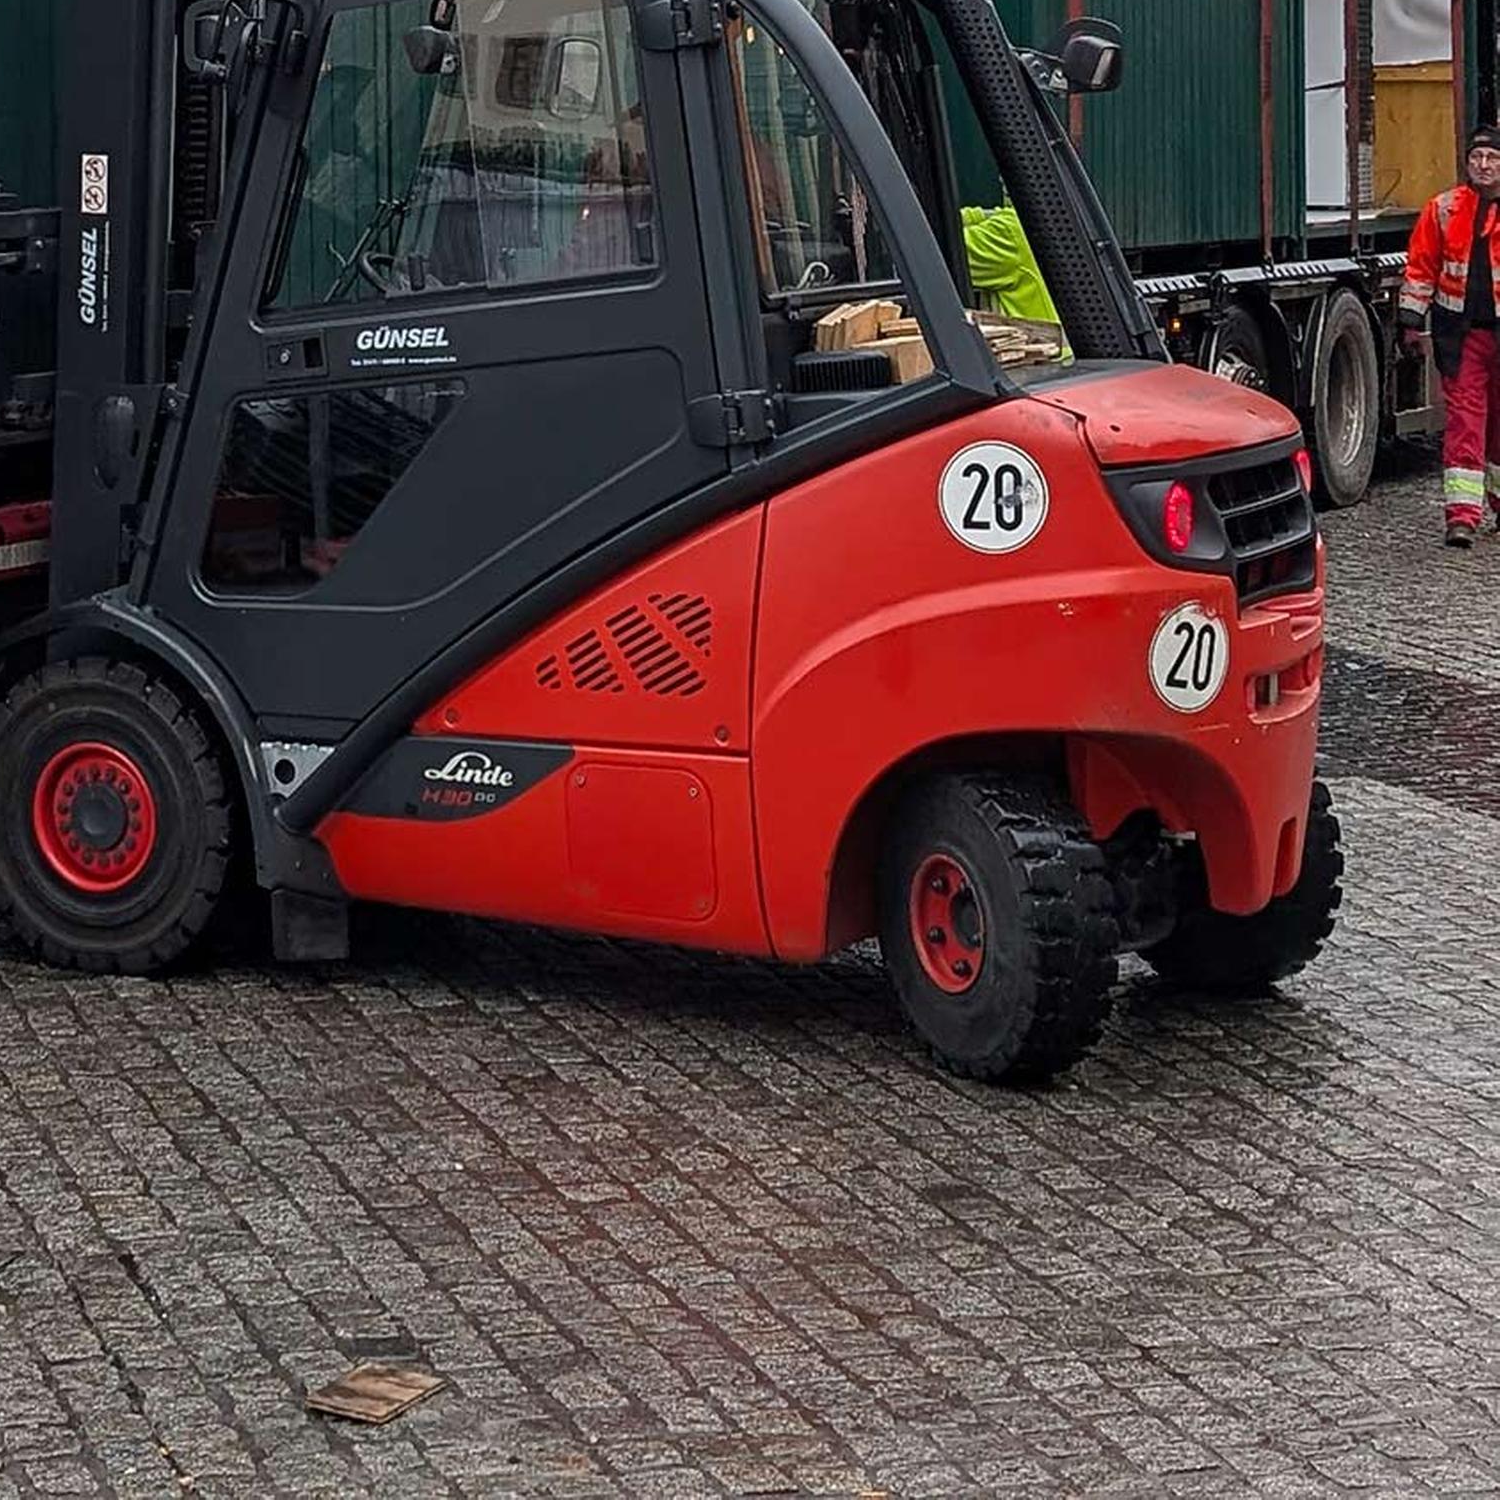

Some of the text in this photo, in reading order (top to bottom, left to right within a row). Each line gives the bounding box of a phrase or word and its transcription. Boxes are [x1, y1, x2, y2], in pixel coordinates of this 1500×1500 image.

[78, 227, 97, 324] GÜNSEL
[356, 325, 449, 350] GÜNSEL
[962, 462, 1023, 531] 20
[1165, 620, 1216, 691] 20
[424, 751, 513, 787] Linde
